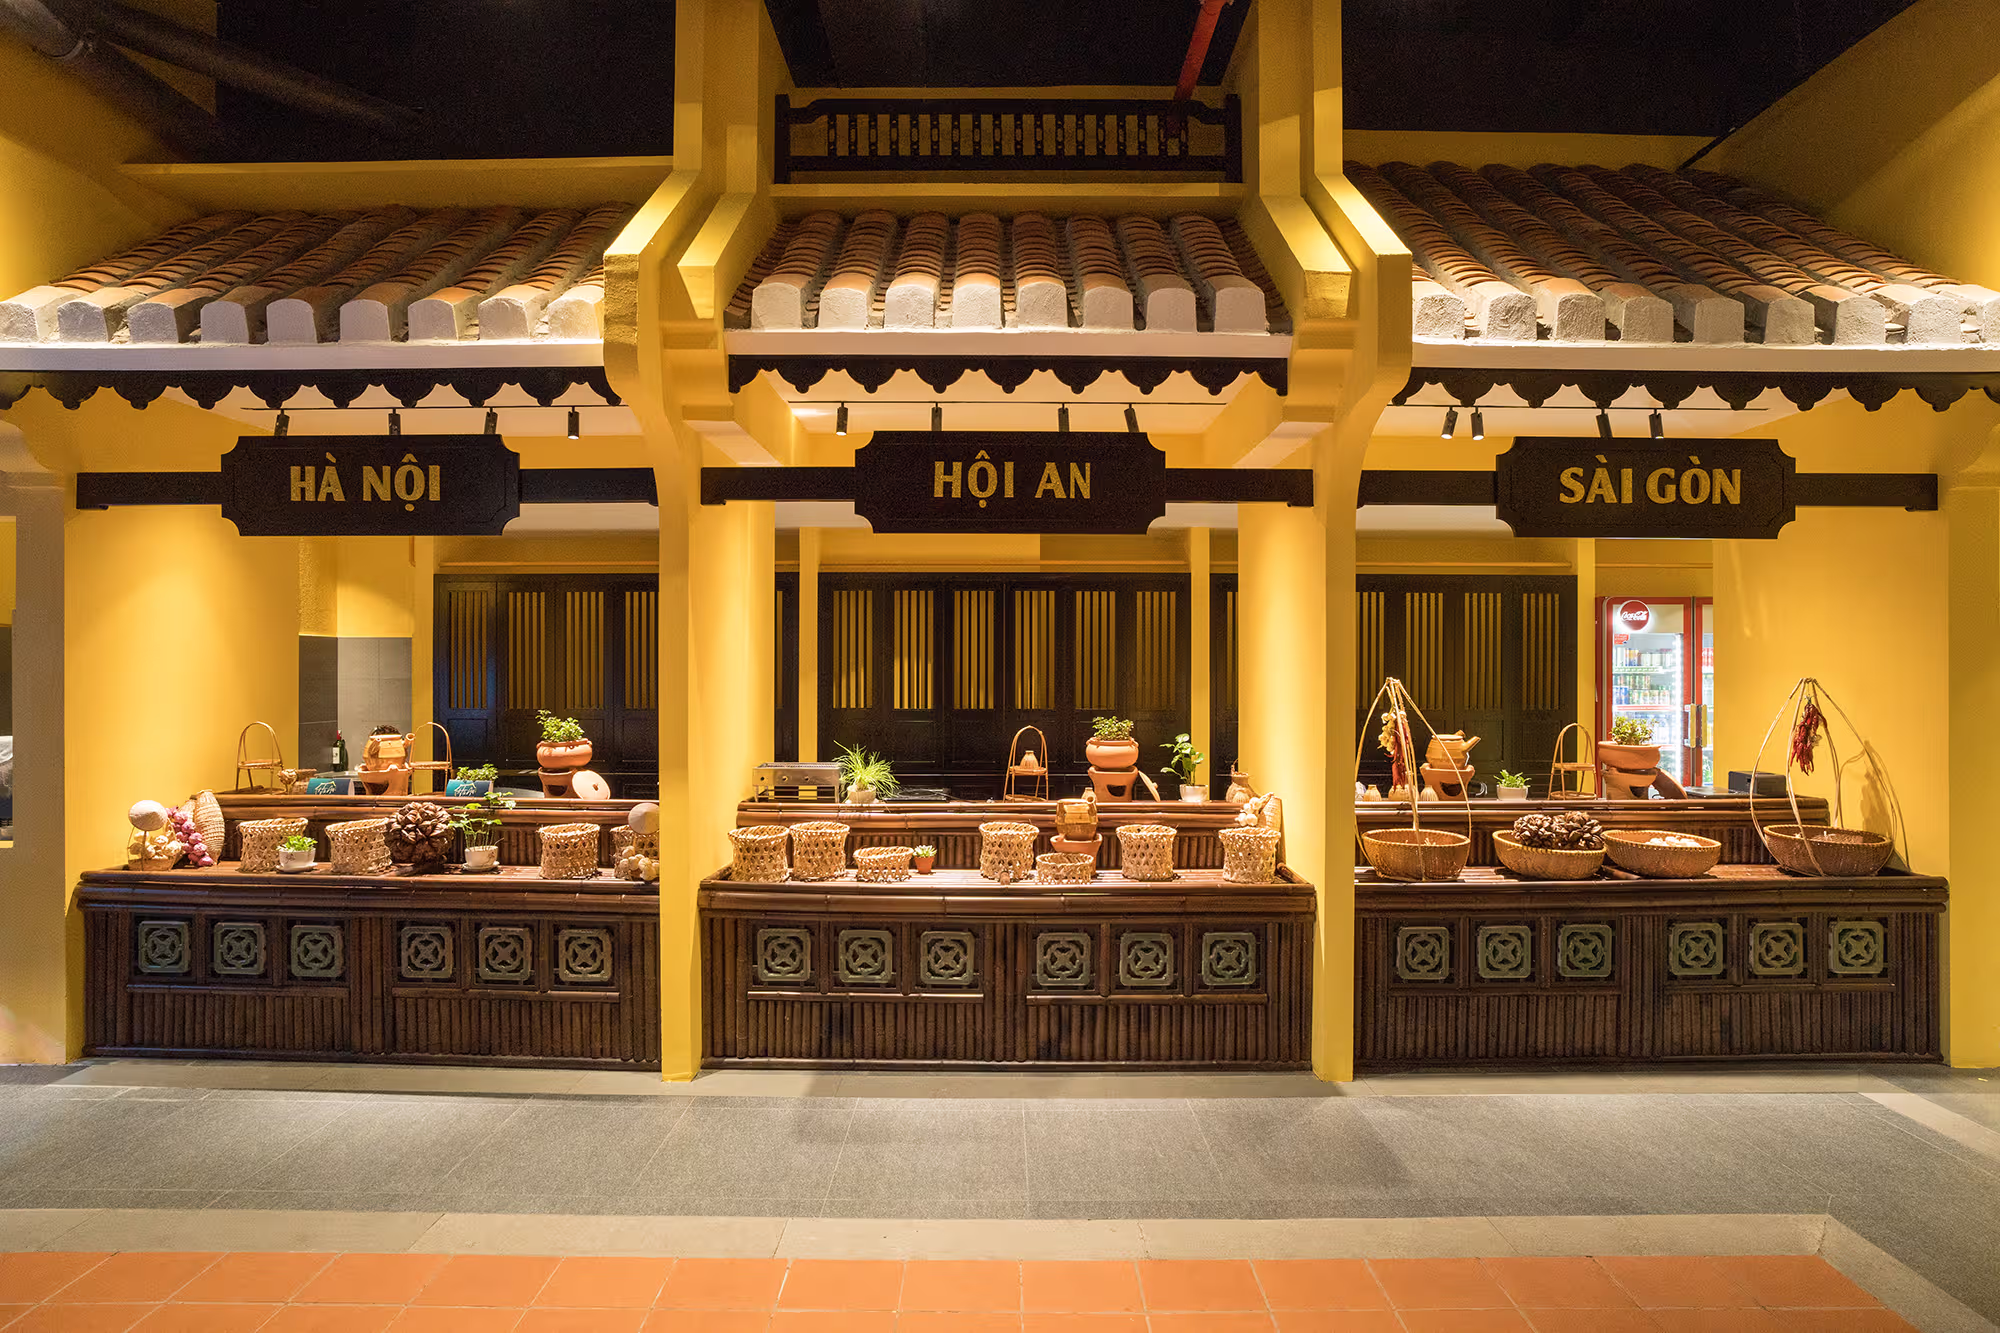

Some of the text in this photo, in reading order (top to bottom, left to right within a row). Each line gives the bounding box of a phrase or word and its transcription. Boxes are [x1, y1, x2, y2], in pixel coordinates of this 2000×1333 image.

[290, 451, 441, 512] HÀ NỘI
[933, 449, 1091, 509] HỘI AN
[1559, 454, 1742, 505] SÀI GÒN
